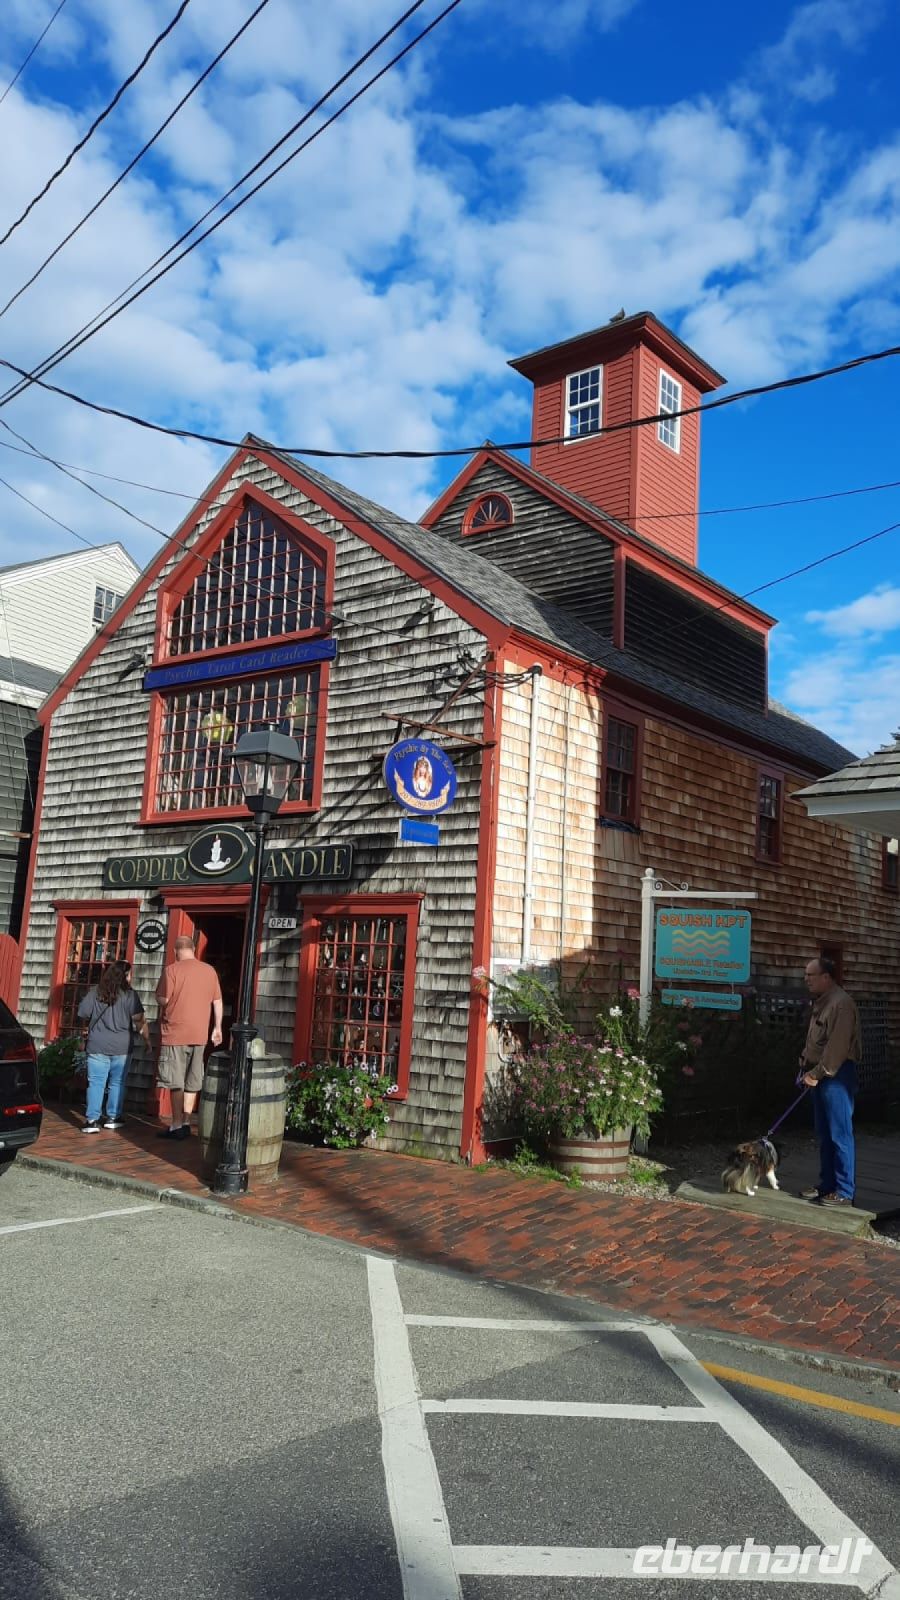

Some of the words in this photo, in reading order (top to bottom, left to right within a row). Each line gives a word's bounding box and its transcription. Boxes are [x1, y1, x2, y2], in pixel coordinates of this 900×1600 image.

[164, 665, 201, 681] Psychic
[207, 660, 236, 675] Tarot
[240, 654, 266, 668] Card
[270, 648, 310, 662] Reader
[108, 857, 189, 883] COPPER
[270, 919, 293, 928] OPEN
[661, 914, 712, 928] SQUISH
